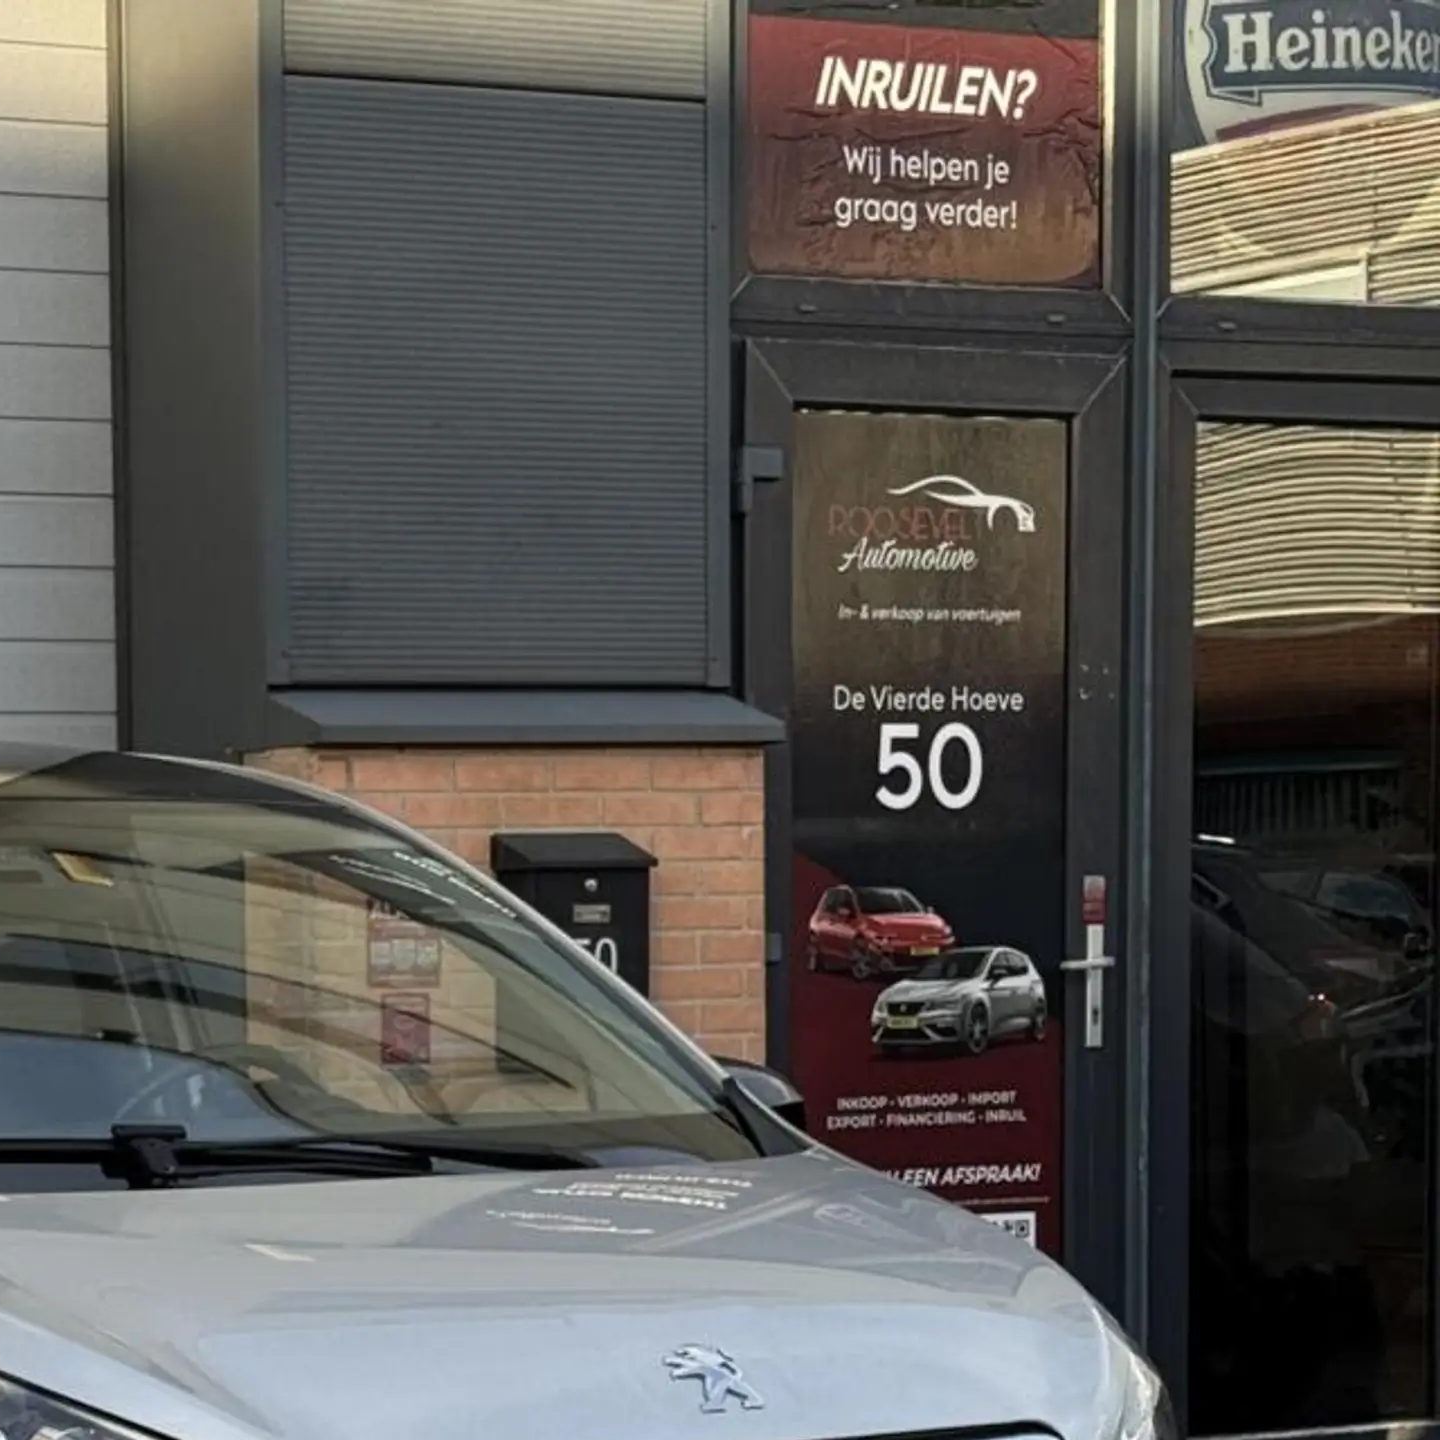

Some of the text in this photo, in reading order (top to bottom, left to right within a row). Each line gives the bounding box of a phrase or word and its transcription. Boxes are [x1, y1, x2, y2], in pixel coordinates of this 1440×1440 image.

[816, 56, 1038, 120] INRUILEN?
[842, 145, 1010, 190] Wij helpen je
[834, 196, 1018, 231] graag verder!
[837, 536, 979, 573] Automotive
[871, 604, 924, 624] verkoop
[926, 609, 949, 621] van
[951, 607, 1022, 626] voertuigen
[833, 684, 1025, 712] De Vierde Hoeve
[875, 722, 983, 810] 50
[837, 1090, 1017, 1111] INKOOP VERKOOP IMPORT
[827, 1109, 1027, 1131] EXPORT FINANCIERING INRUIL
[939, 1163, 1043, 1186] AFSPRAAK!
